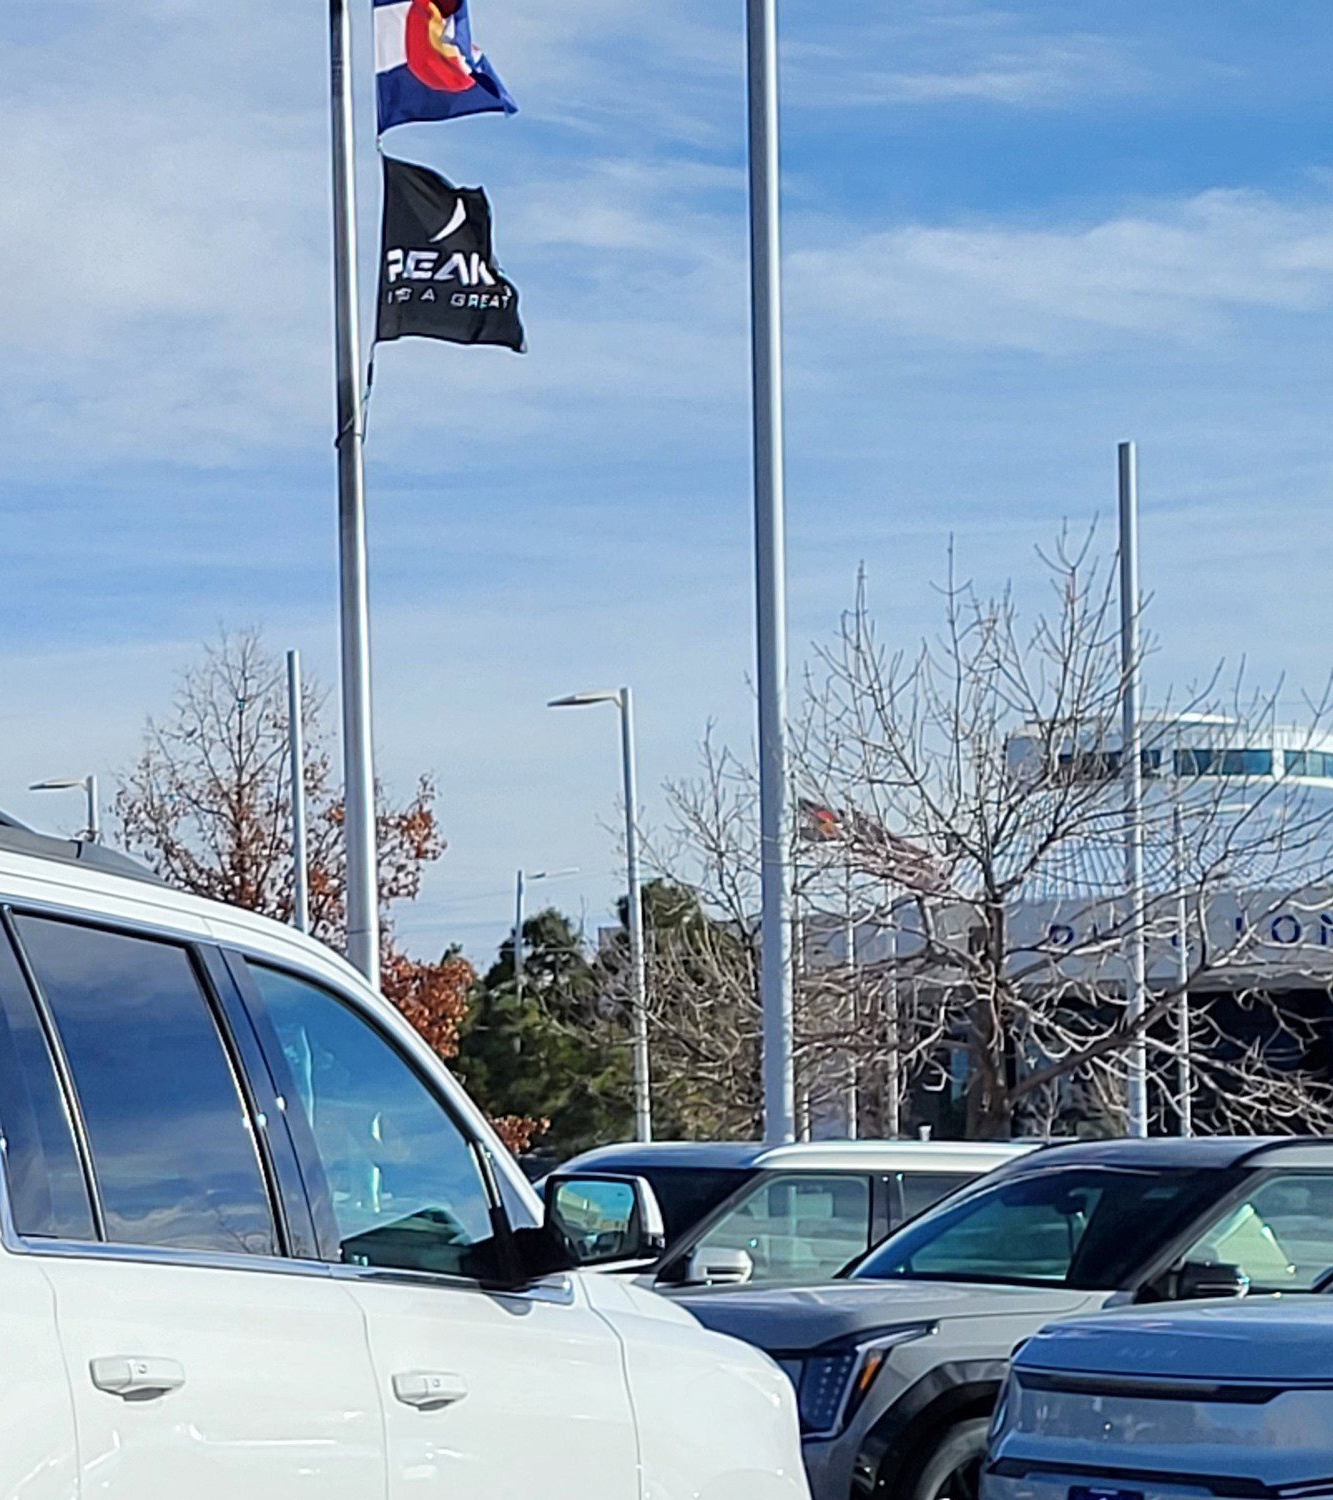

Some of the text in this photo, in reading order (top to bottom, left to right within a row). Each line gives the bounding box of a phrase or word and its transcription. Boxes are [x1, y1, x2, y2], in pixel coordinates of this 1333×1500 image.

[386, 248, 496, 286] PEAK
[420, 288, 435, 302] A
[450, 292, 510, 309] GREAT
